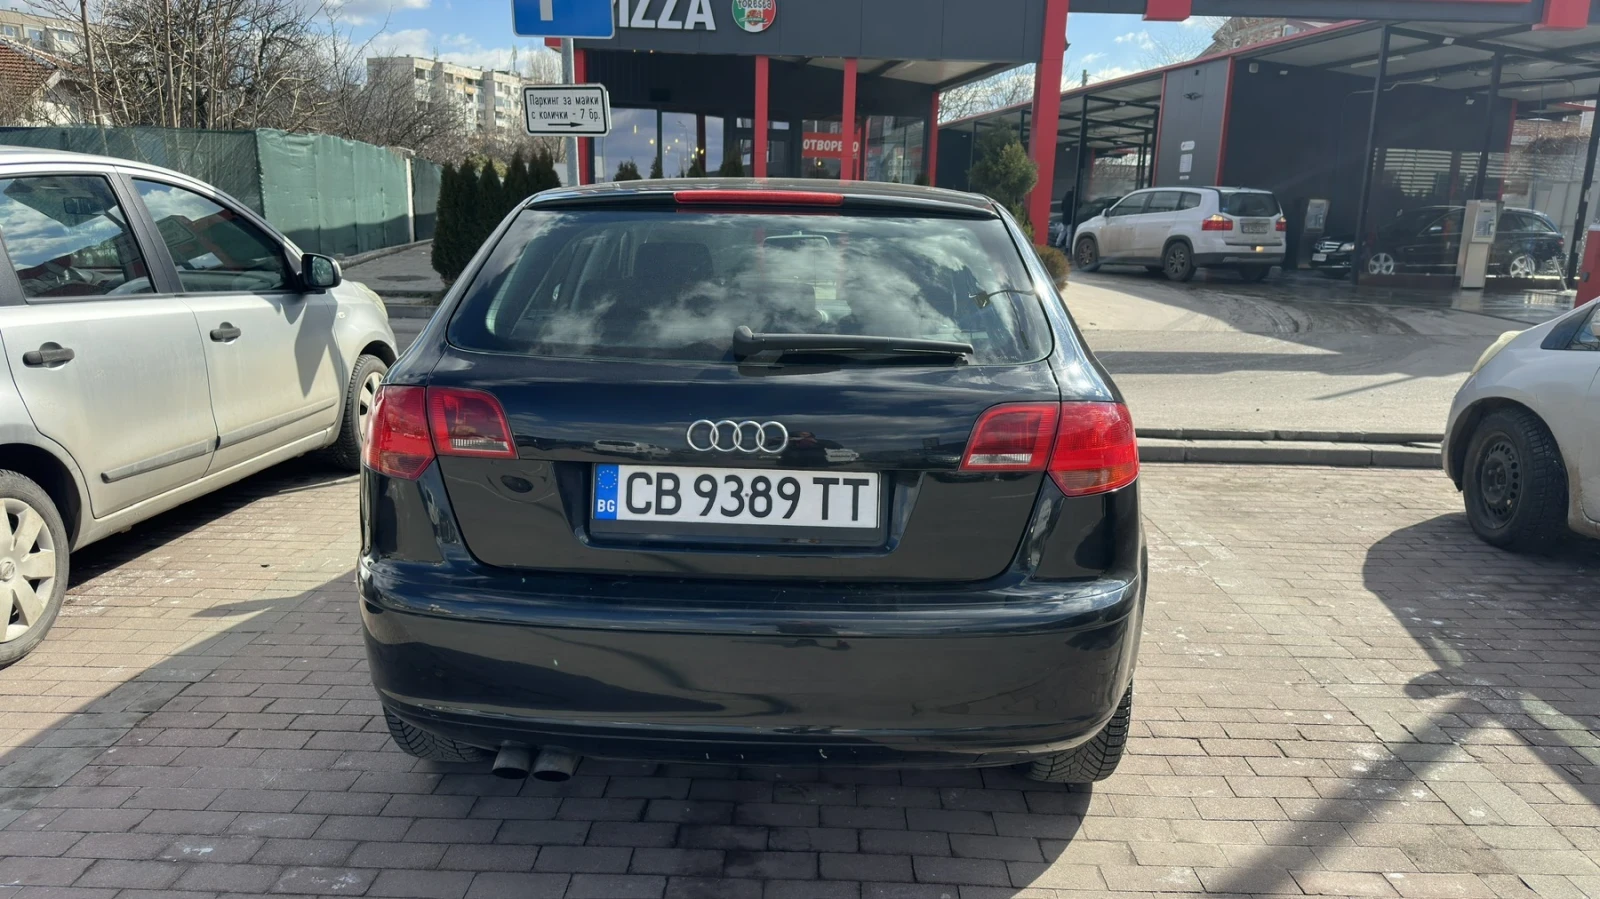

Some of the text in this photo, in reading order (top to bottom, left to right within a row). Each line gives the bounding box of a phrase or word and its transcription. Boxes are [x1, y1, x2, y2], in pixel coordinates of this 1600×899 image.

[614, 0, 716, 30] IZZA
[529, 94, 599, 107] Паркинг за майки
[531, 111, 536, 119] с
[540, 111, 568, 119] колички
[580, 109, 585, 119] 7
[589, 109, 600, 122] бр.
[803, 139, 859, 152] ОТВОРЕО
[597, 472, 869, 521] BG CB 9389 TT
